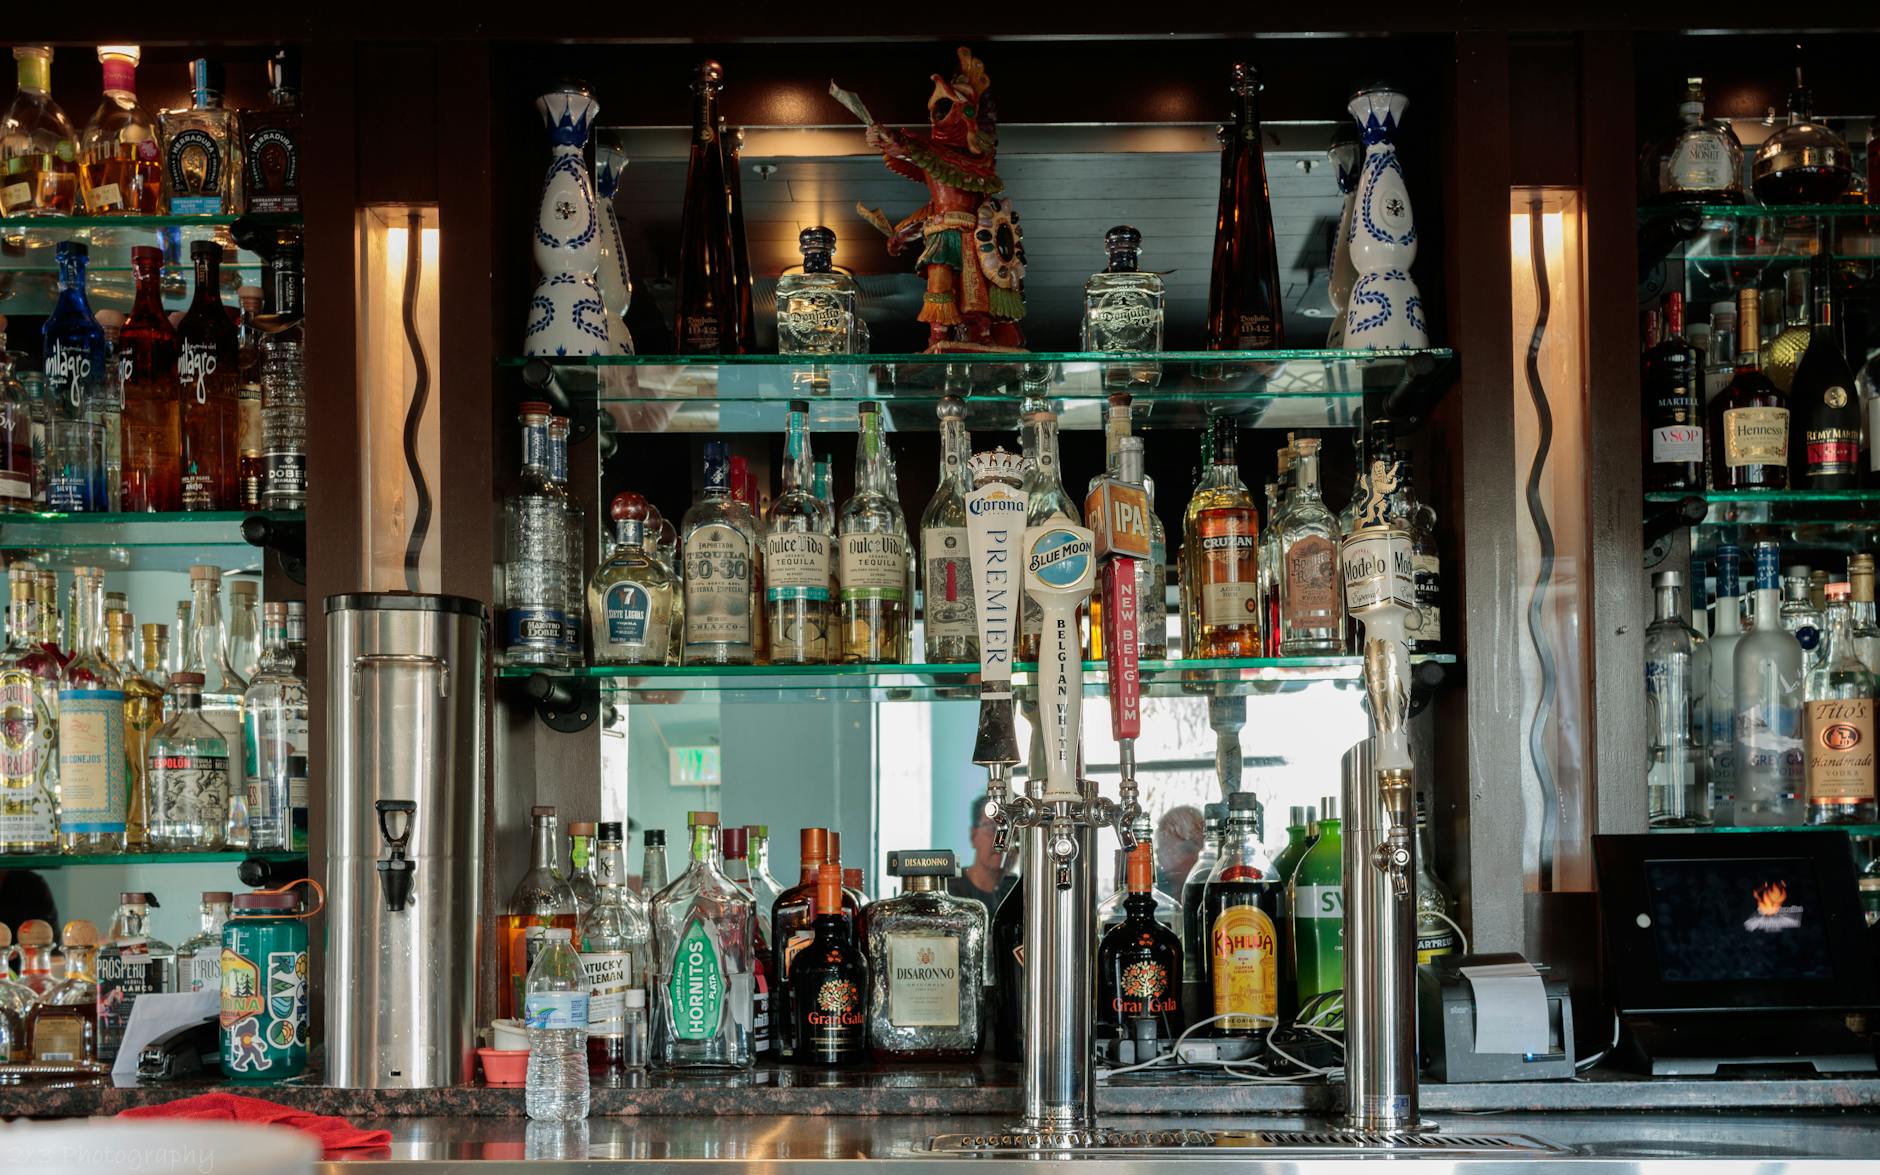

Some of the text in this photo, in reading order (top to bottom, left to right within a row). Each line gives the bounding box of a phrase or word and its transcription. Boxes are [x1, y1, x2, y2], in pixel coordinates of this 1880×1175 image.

[173, 135, 215, 154] HERRADURA
[251, 132, 293, 153] HERRADURA
[45, 338, 91, 407] milagro
[1659, 397, 1700, 407] MARTELL
[1661, 431, 1699, 443] VSOP
[1737, 425, 1784, 438] Hennessy
[969, 497, 1024, 517] Corona
[1114, 500, 1146, 538] IPA
[769, 536, 797, 556] Dulce
[1203, 536, 1253, 550] CRUZAN
[686, 552, 746, 560] TEQUILA
[776, 558, 816, 566] TEQUILA
[858, 559, 897, 567] TEQUILA
[1029, 542, 1092, 573] BLUE MOON
[686, 559, 747, 581] 30-30
[1344, 555, 1387, 582] Modelo
[623, 587, 635, 605] 7
[986, 530, 1008, 666] PREMIER
[527, 622, 561, 630] MAESTRO
[528, 628, 560, 638] DOBEL
[1121, 583, 1137, 721] NEW BELGIUM
[1056, 619, 1069, 761] BELGIAN WHITE
[1816, 702, 1867, 721] Tito's
[69, 754, 101, 765] CONEJOS
[1811, 753, 1873, 769] Handmade
[1825, 769, 1860, 777] VODKA
[904, 857, 949, 867] DISARONNO
[1214, 930, 1274, 957] KAHLÚA
[897, 967, 955, 981] DISARONNO
[688, 940, 705, 1034] HORNITOS
[708, 974, 718, 1000] PLATA
[808, 1011, 841, 1025] Gran
